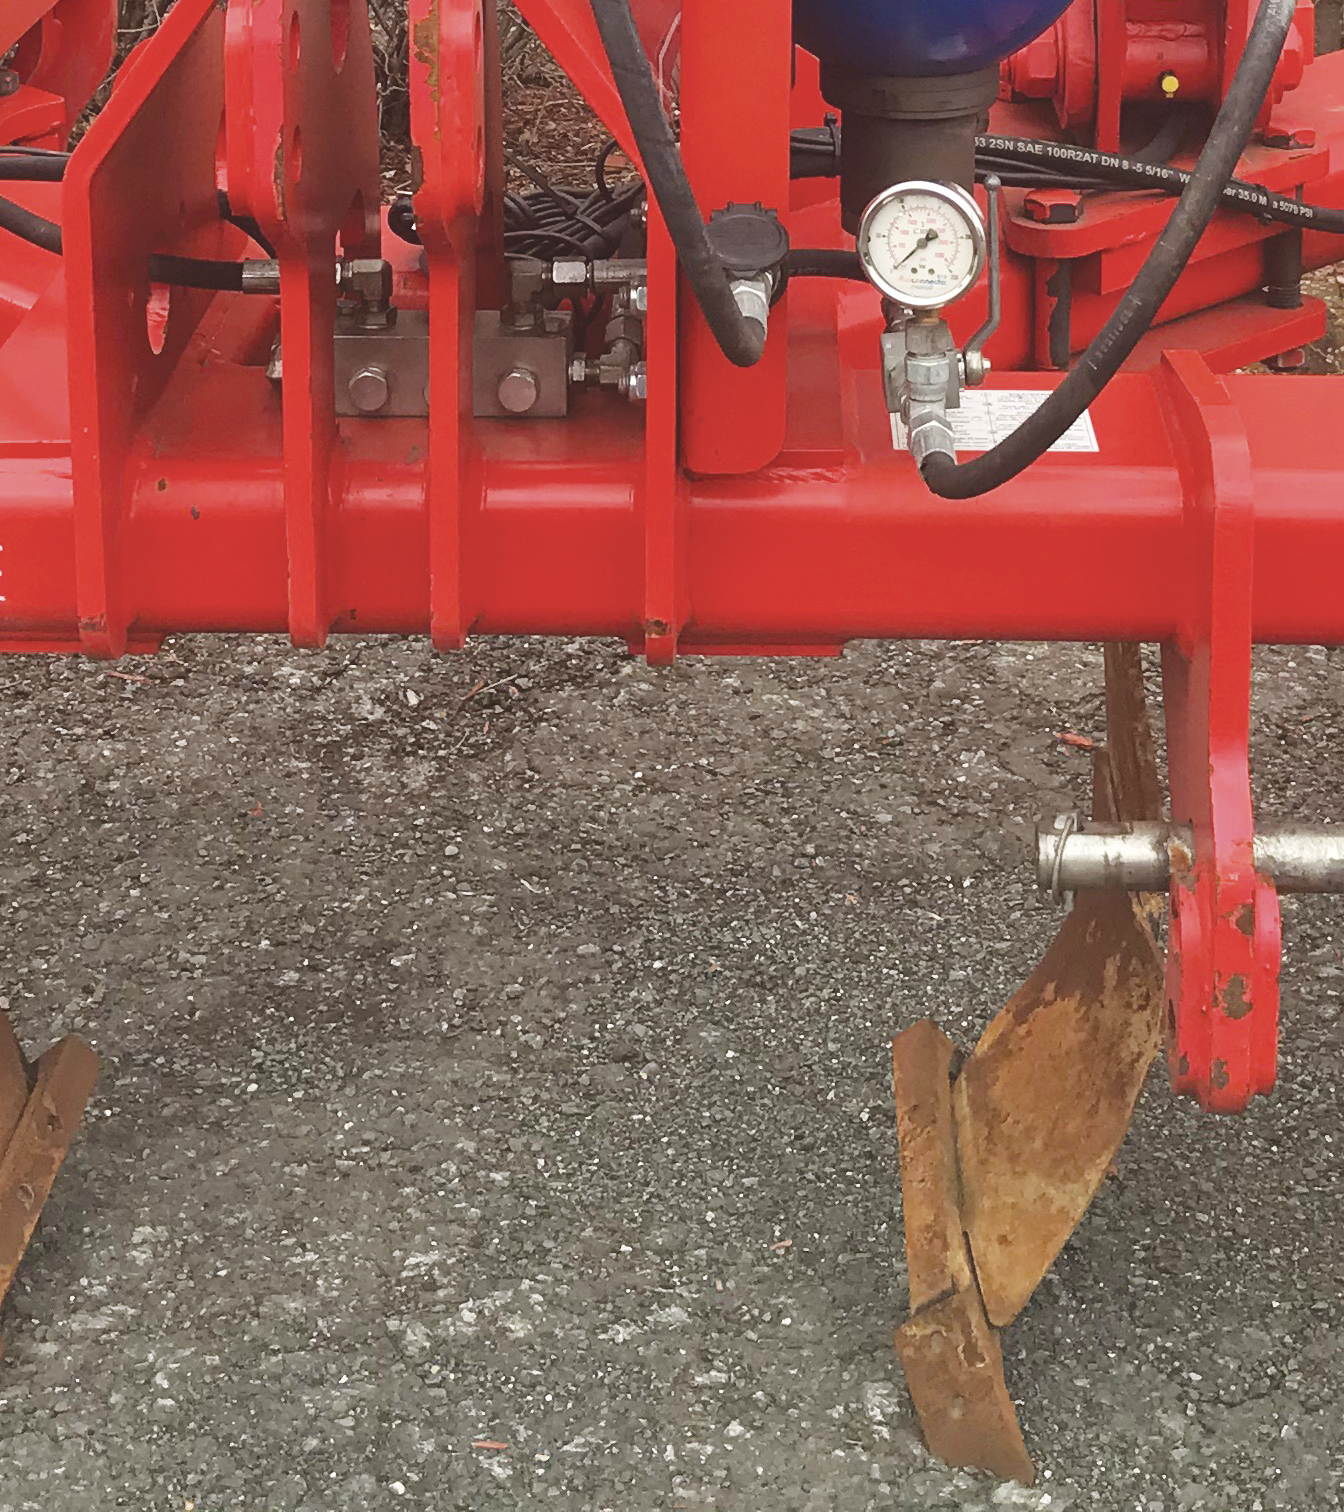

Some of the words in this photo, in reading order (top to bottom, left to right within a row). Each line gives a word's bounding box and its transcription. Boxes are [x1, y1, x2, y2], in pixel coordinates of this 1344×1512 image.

[989, 139, 1014, 150] 2SN
[1017, 142, 1043, 154] SAE
[1047, 147, 1098, 164] 100R2AT
[1101, 156, 1119, 167] DN
[1121, 160, 1129, 170] 8
[1299, 207, 1313, 218] PSI
